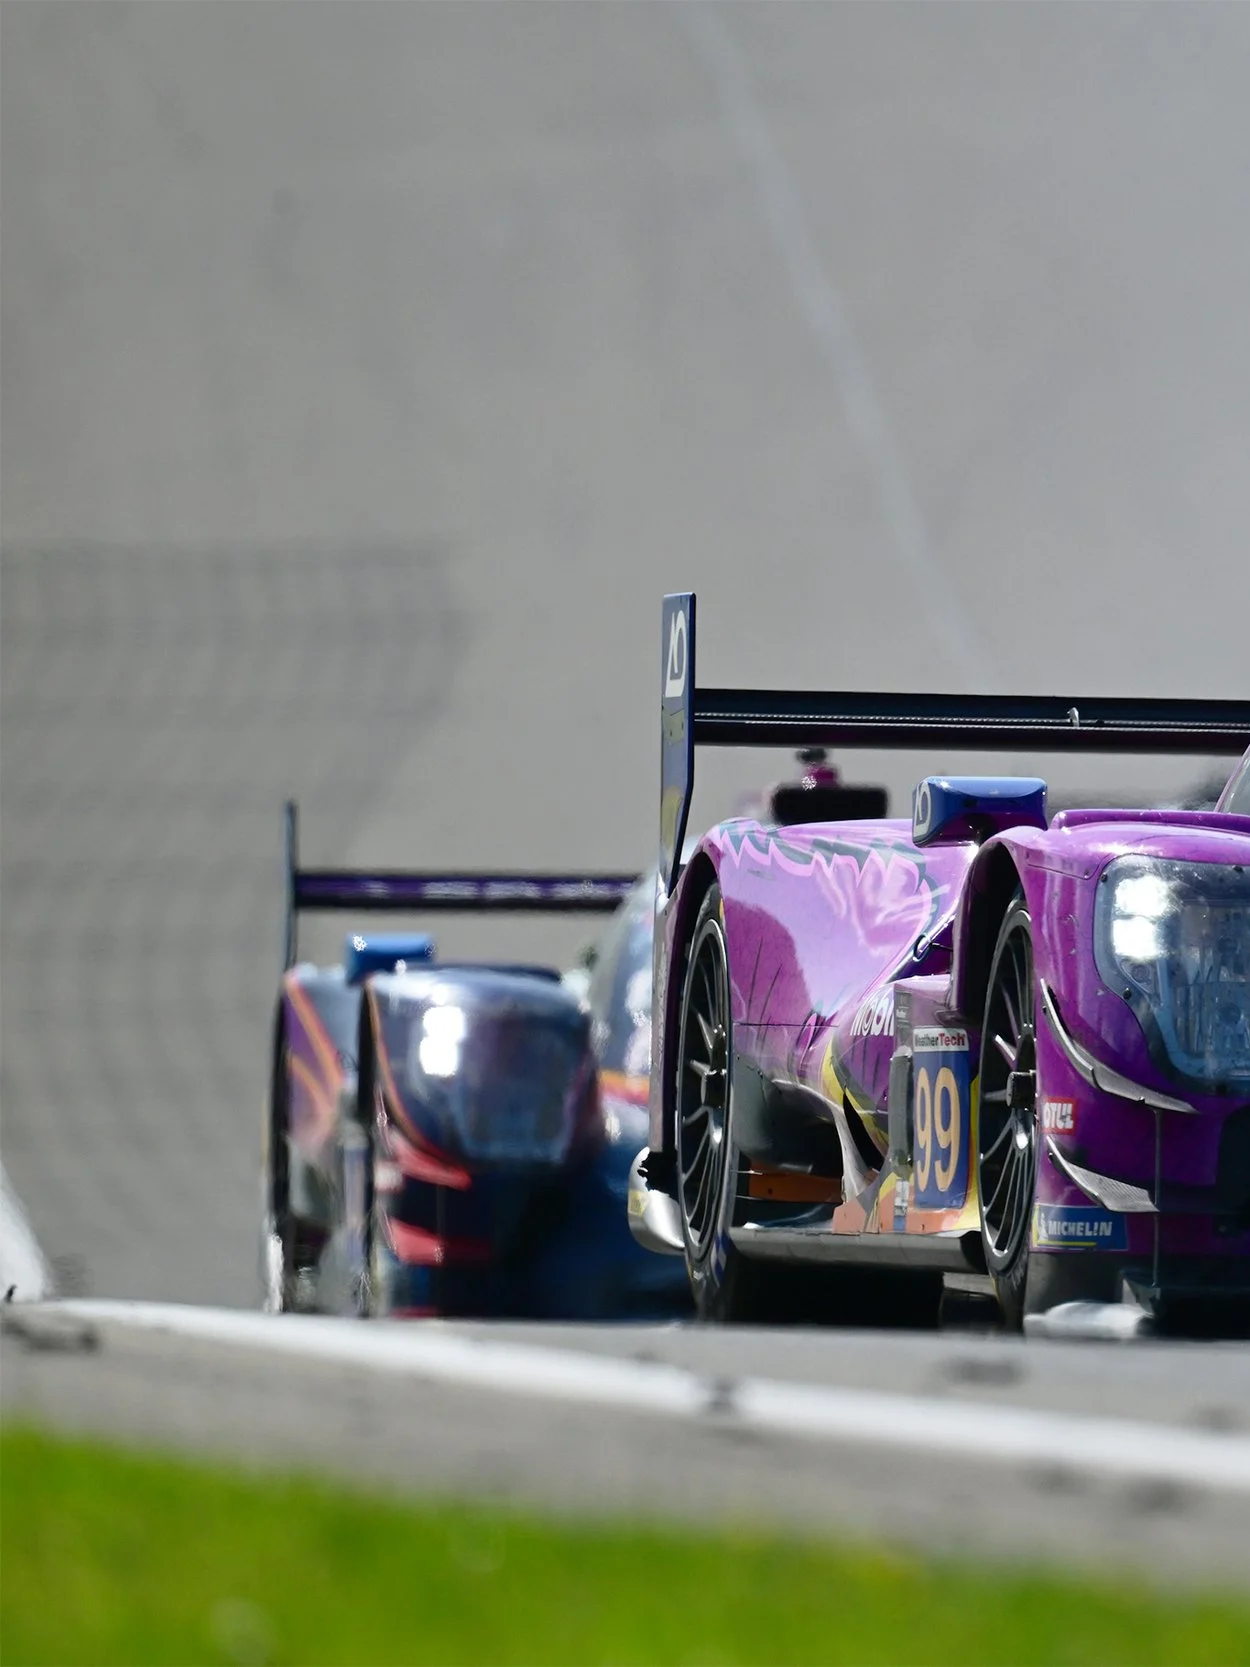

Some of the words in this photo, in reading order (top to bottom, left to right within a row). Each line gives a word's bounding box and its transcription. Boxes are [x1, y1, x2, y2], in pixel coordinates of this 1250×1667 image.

[916, 1066, 961, 1193] 99
[1043, 1102, 1074, 1130] OTUL
[1048, 1221, 1113, 1237] MICHELIN
